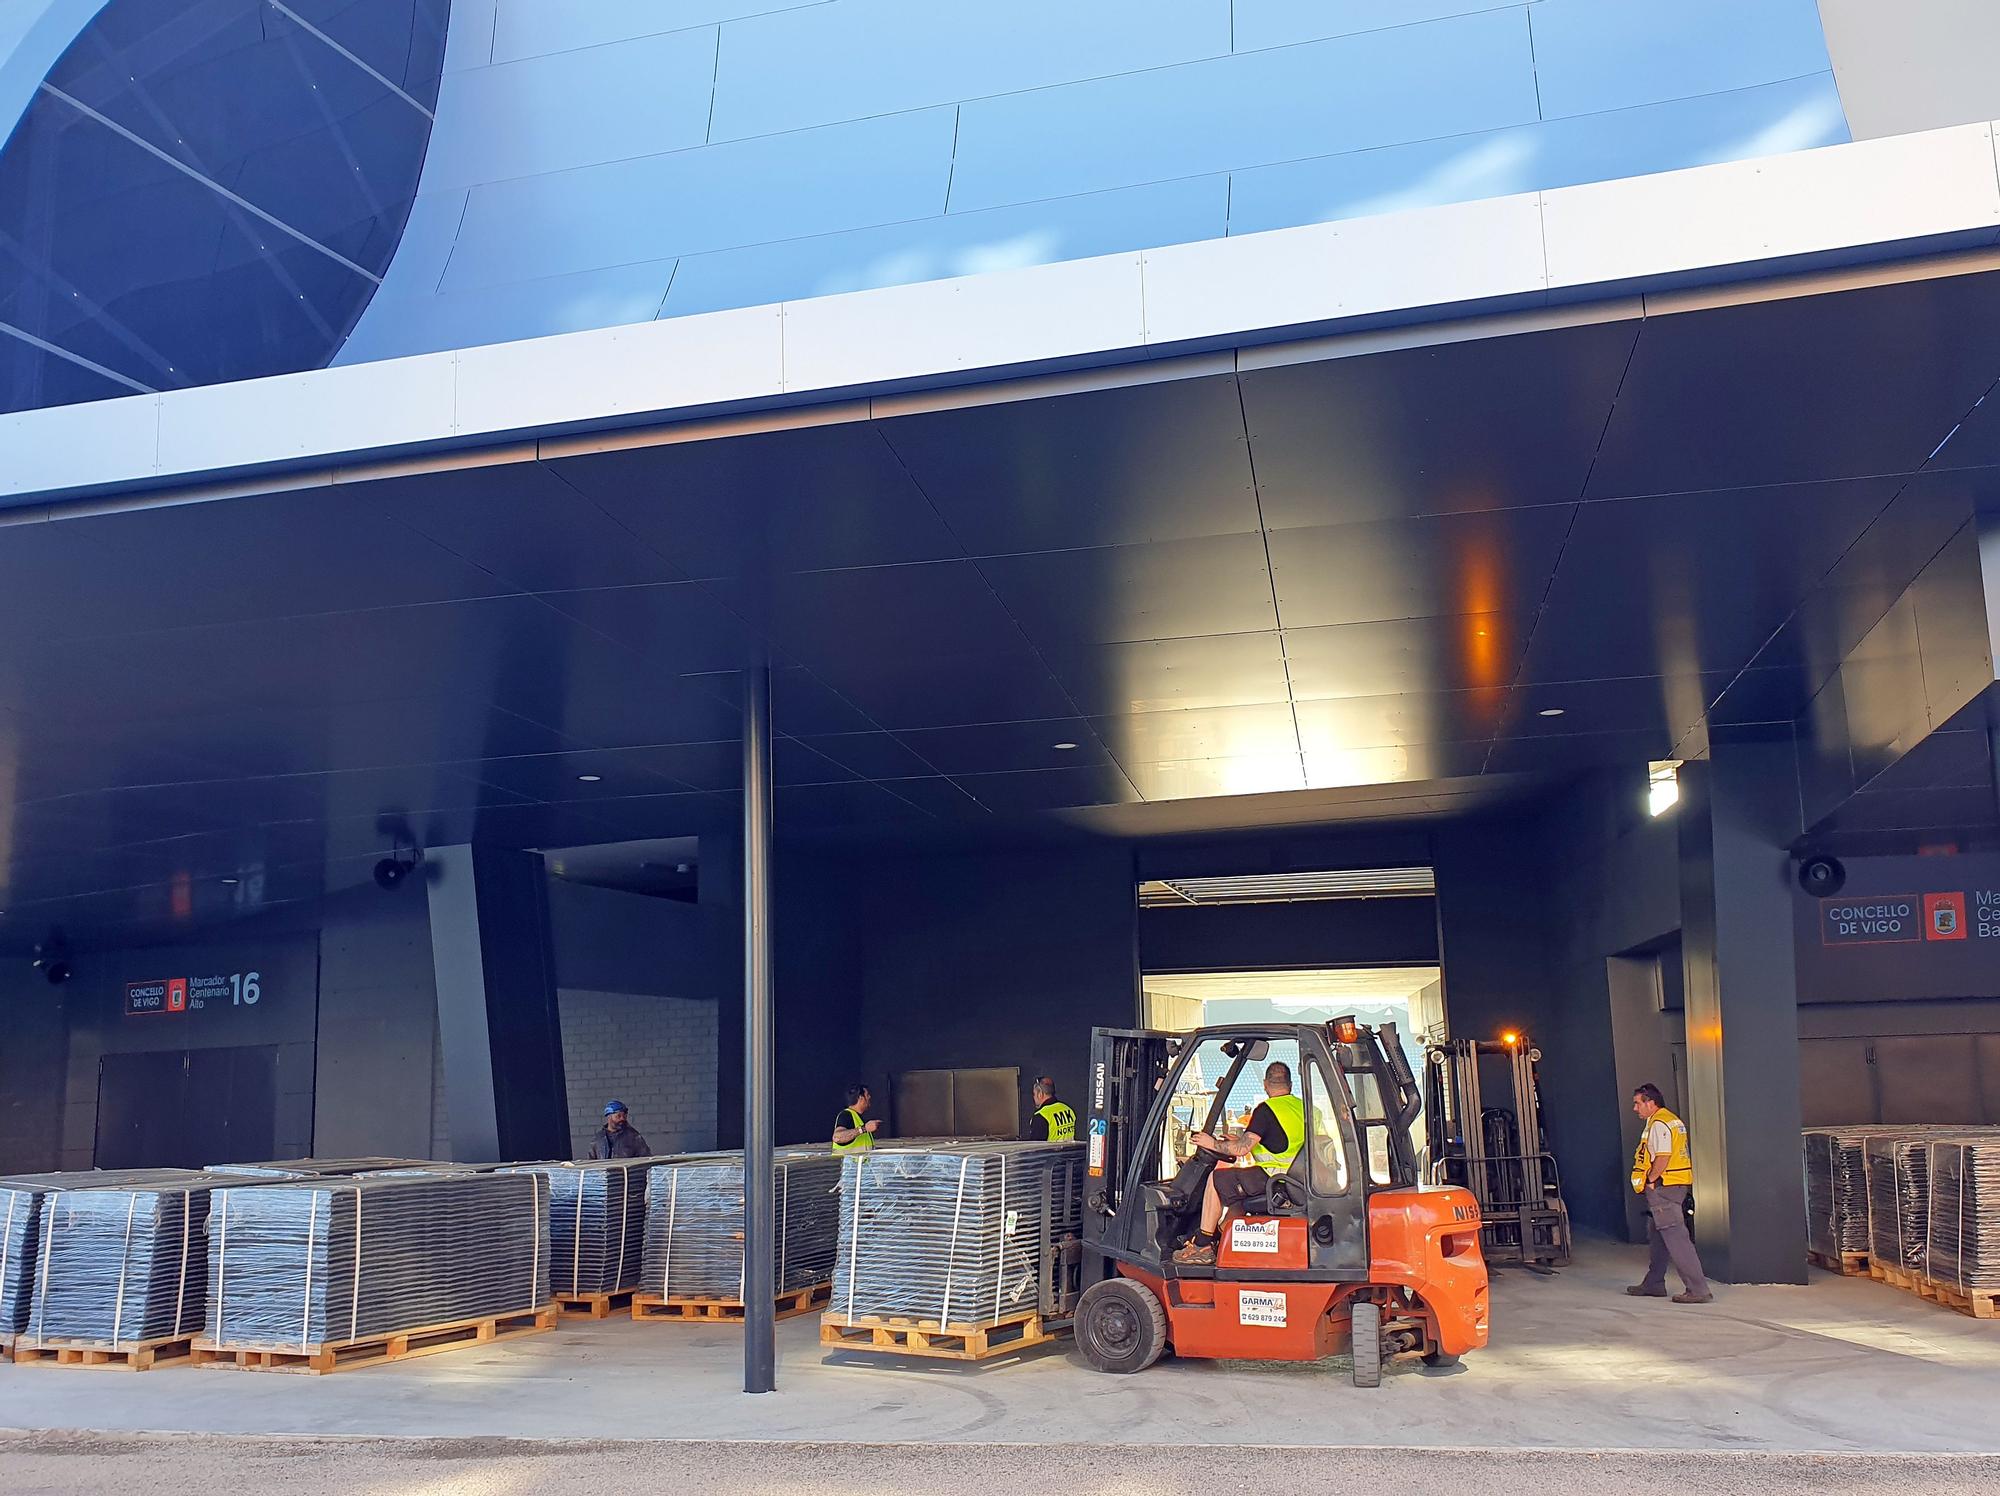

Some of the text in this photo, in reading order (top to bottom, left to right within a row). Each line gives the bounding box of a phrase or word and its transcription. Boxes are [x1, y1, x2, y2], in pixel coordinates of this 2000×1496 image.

[1829, 904, 1910, 921] CONCELLO
[1839, 919, 1901, 935] DE VIGO
[189, 975, 225, 988] Marcador
[130, 985, 164, 998] CONCELLO
[189, 986, 230, 999] Centenario
[230, 971, 260, 1006] 16
[133, 996, 160, 1008] DE VIGO
[189, 999, 204, 1009] Alto
[1095, 1062, 1105, 1110] NISSAN
[1053, 1109, 1074, 1126] MK
[1089, 1118, 1107, 1135] 26
[1234, 1224, 1266, 1233] GARMA
[1252, 1240, 1264, 1248] 879
[1241, 1297, 1273, 1306] GARMA
[1248, 1313, 1260, 1321] 629
[1260, 1314, 1273, 1322] 879
